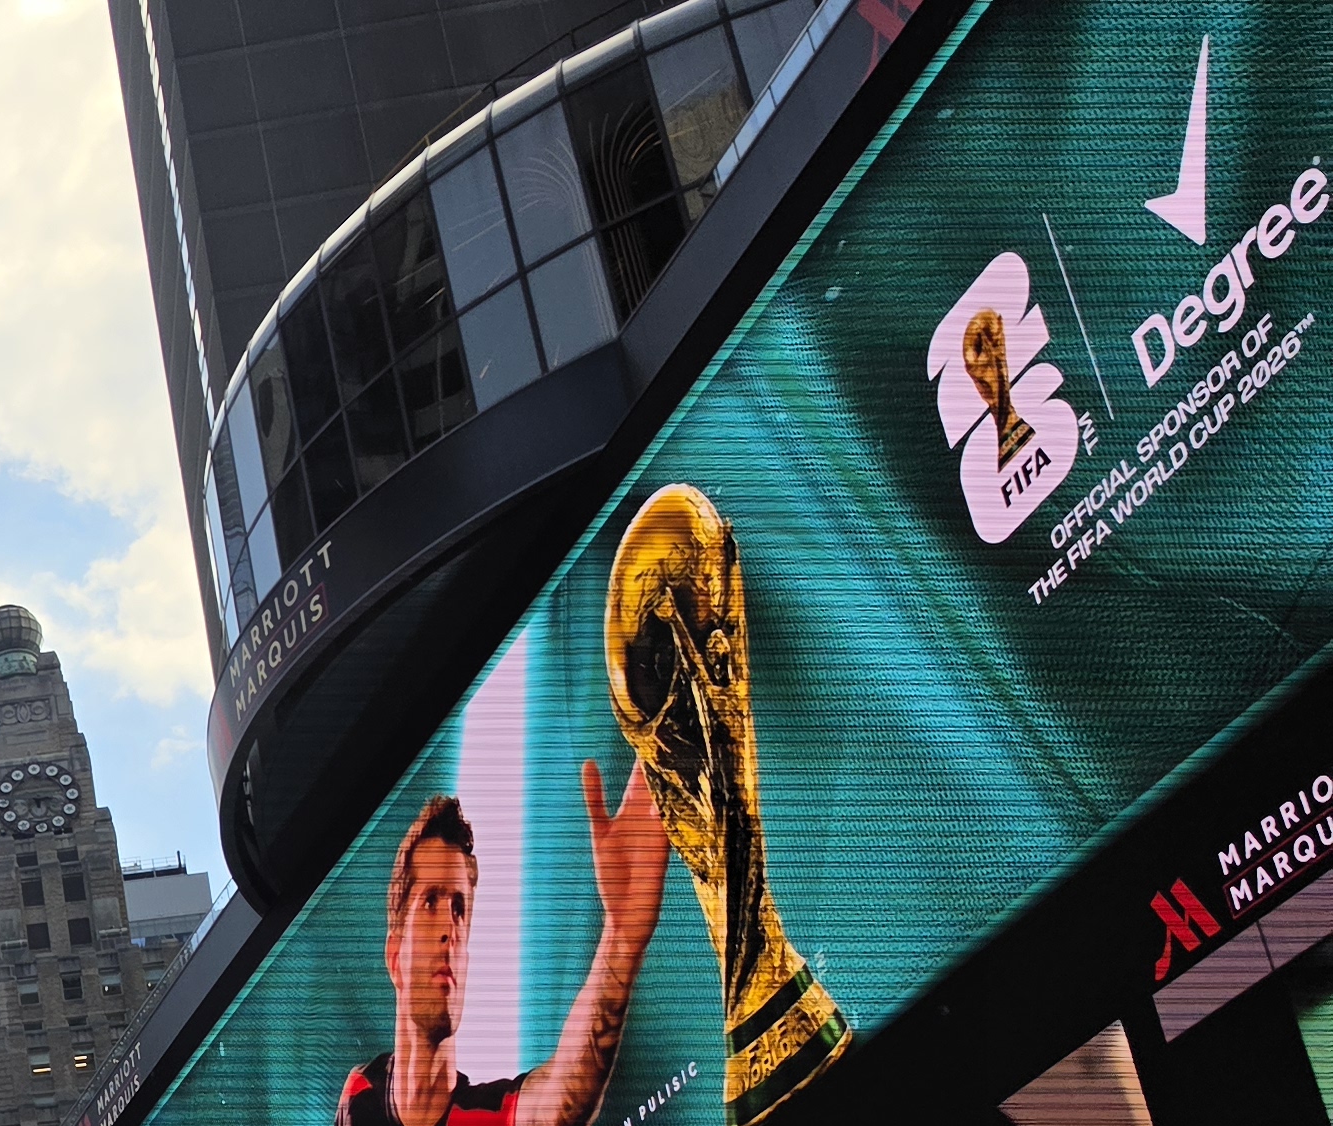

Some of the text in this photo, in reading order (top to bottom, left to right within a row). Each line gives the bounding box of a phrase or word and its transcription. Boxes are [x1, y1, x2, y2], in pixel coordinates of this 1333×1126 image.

[1131, 167, 1330, 389] Degree
[1001, 447, 1053, 508] FIFA
[1028, 557, 1068, 605] THE
[1067, 518, 1113, 571] FIFA
[1109, 443, 1189, 526] WORLD
[1188, 394, 1235, 450] CUP
[1049, 313, 1274, 550] OFFICIAL SPONSOR OF
[229, 540, 333, 687] MARRIOTT
[234, 594, 325, 722] MARQUIS
[96, 1041, 142, 1115] MARRIOTT
[638, 1061, 698, 1121] PULISIC
